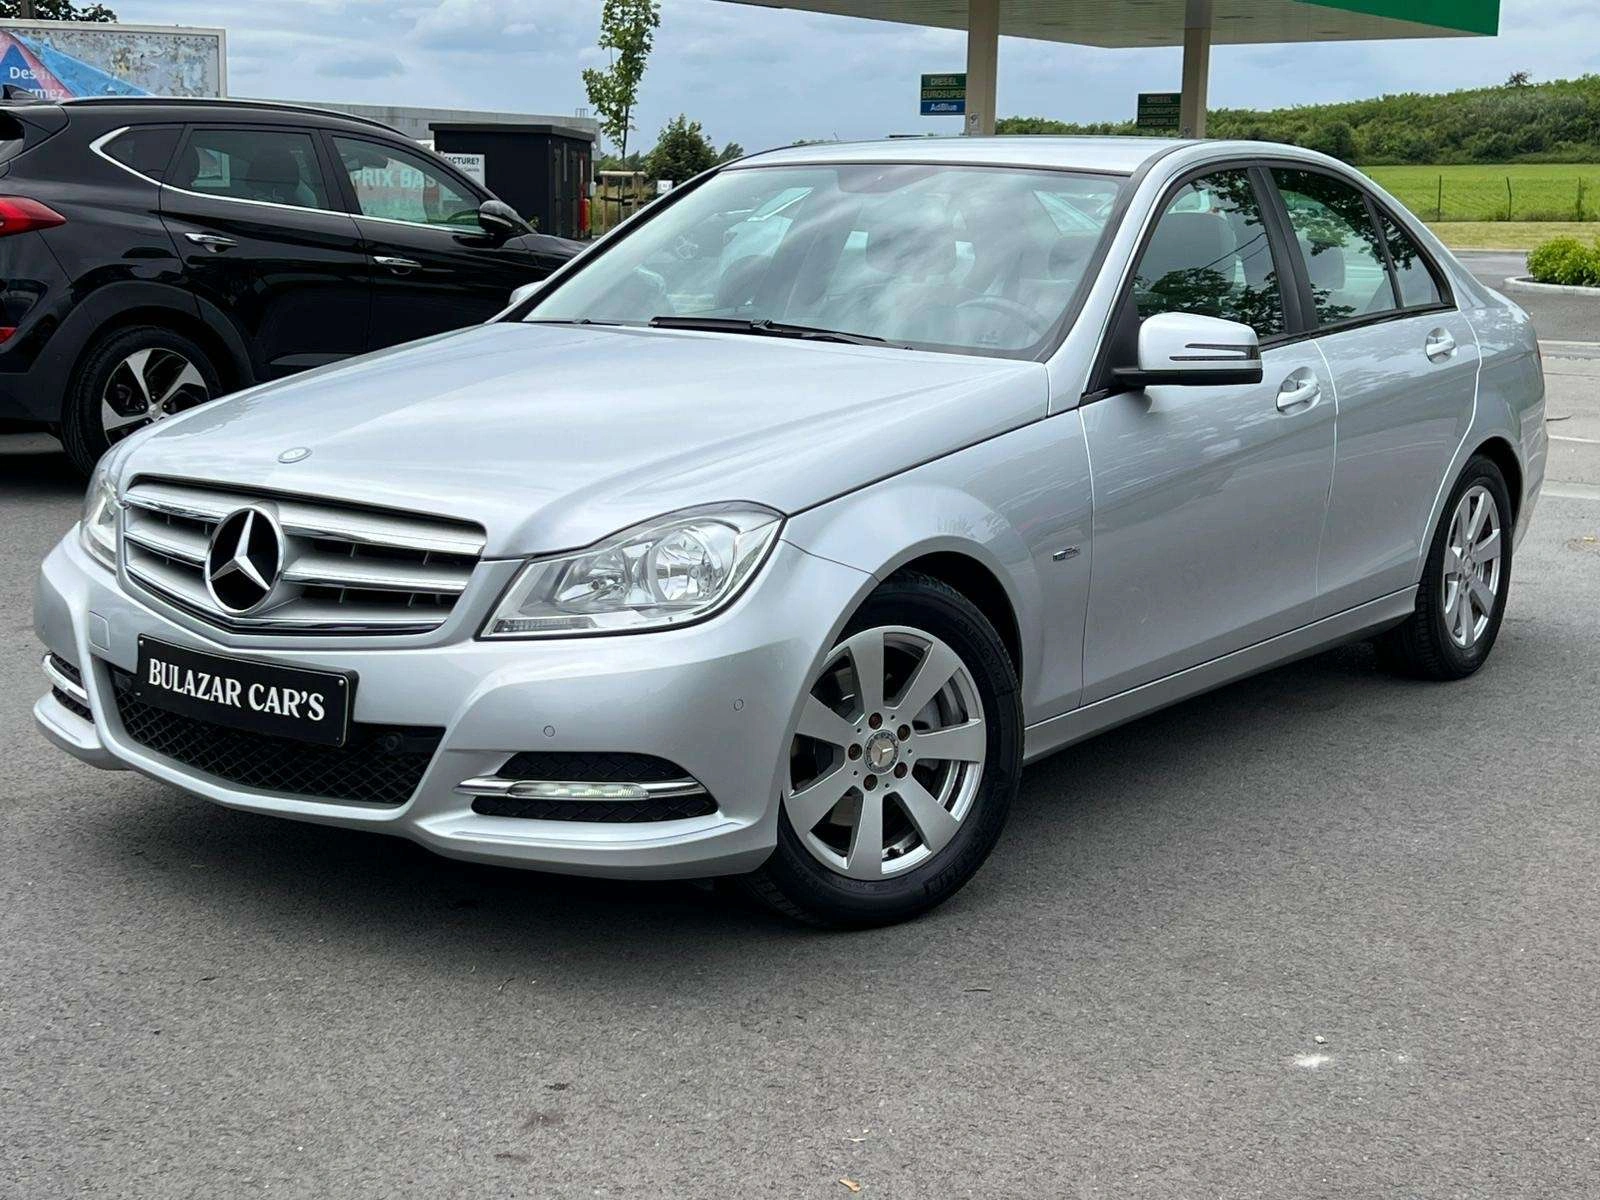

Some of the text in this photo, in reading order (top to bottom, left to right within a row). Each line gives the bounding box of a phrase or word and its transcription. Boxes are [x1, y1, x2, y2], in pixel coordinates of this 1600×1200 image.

[930, 77, 959, 86] DIESEL
[28, 88, 65, 100] rmez
[929, 103, 958, 112] AdBlue
[448, 156, 480, 165] CTURE?
[148, 658, 325, 721] BULAZAR CAR'S
